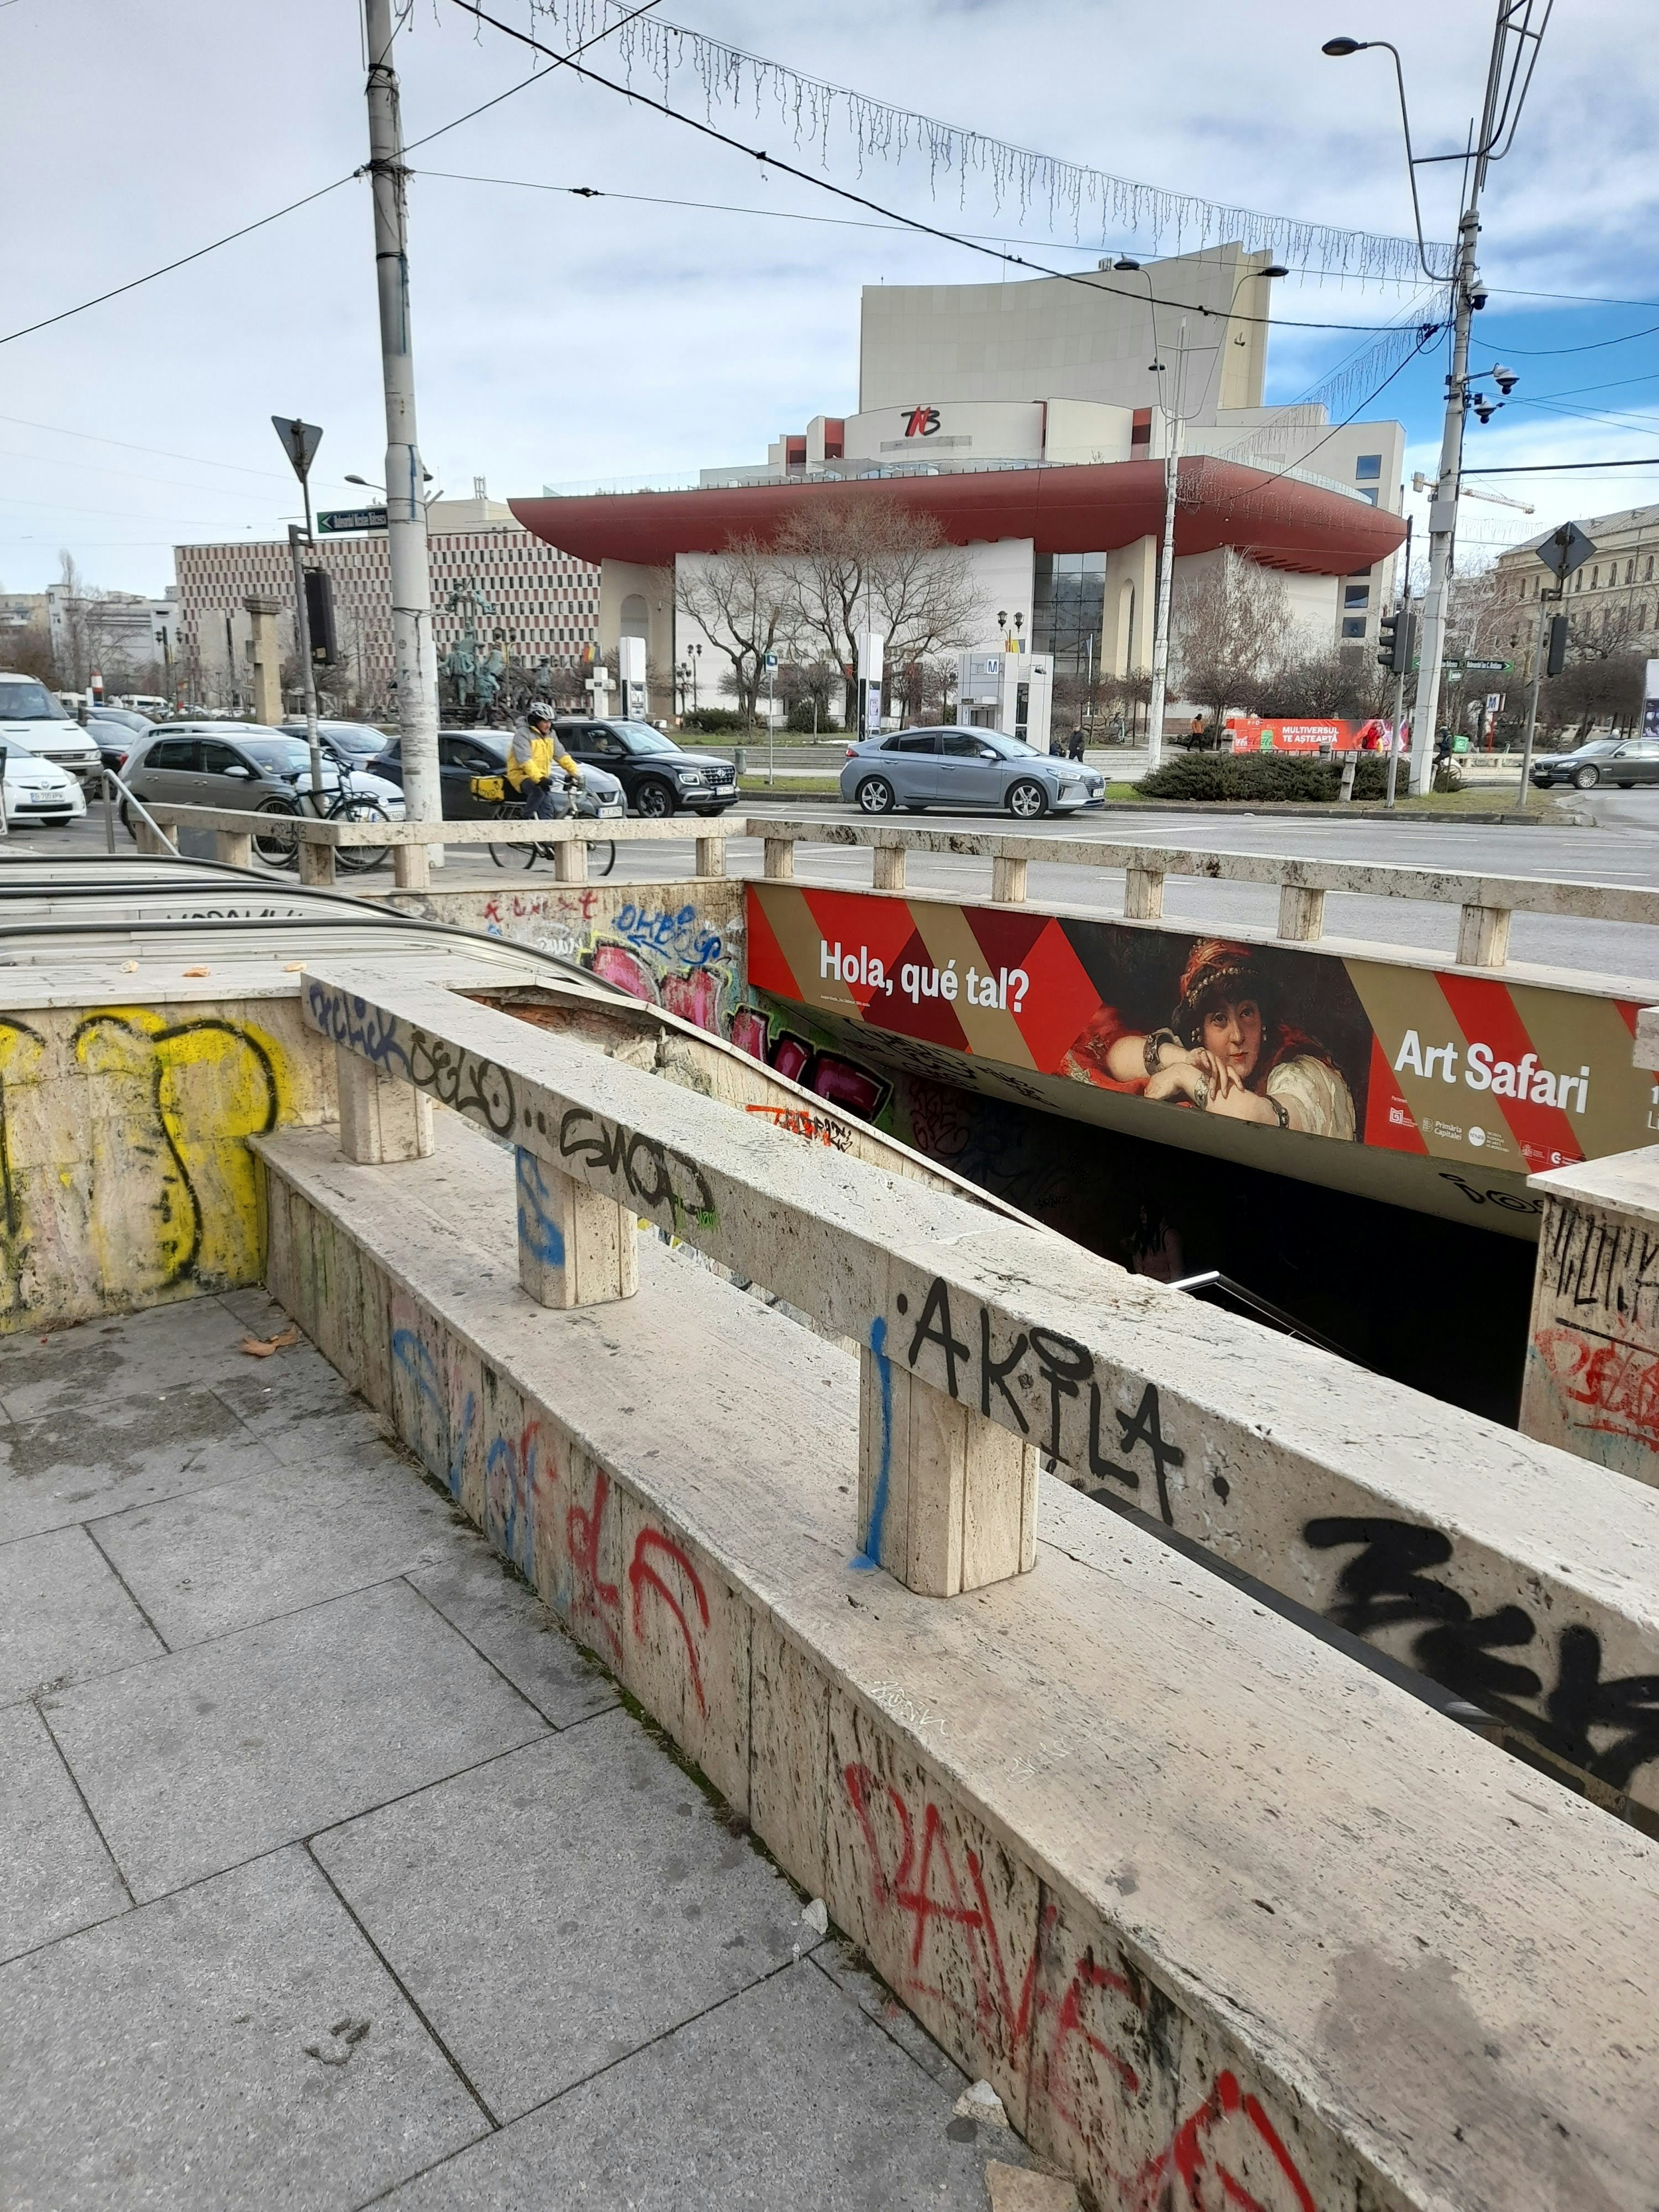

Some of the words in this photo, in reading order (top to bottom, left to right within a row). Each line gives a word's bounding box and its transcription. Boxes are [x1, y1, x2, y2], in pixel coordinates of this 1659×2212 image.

[901, 406, 941, 437] TNB
[988, 661, 997, 673] M
[1488, 696, 1497, 709] M
[1282, 726, 1339, 734] MULTIVERSUL
[820, 939, 893, 997] Hola,
[901, 959, 959, 1004] qué
[965, 966, 1030, 1013] tal?
[1394, 1029, 1459, 1084] Art
[1465, 1042, 1590, 1114] Safari
[1435, 1120, 1462, 1133] Primăria
[1434, 1128, 1462, 1141] Capitalei
